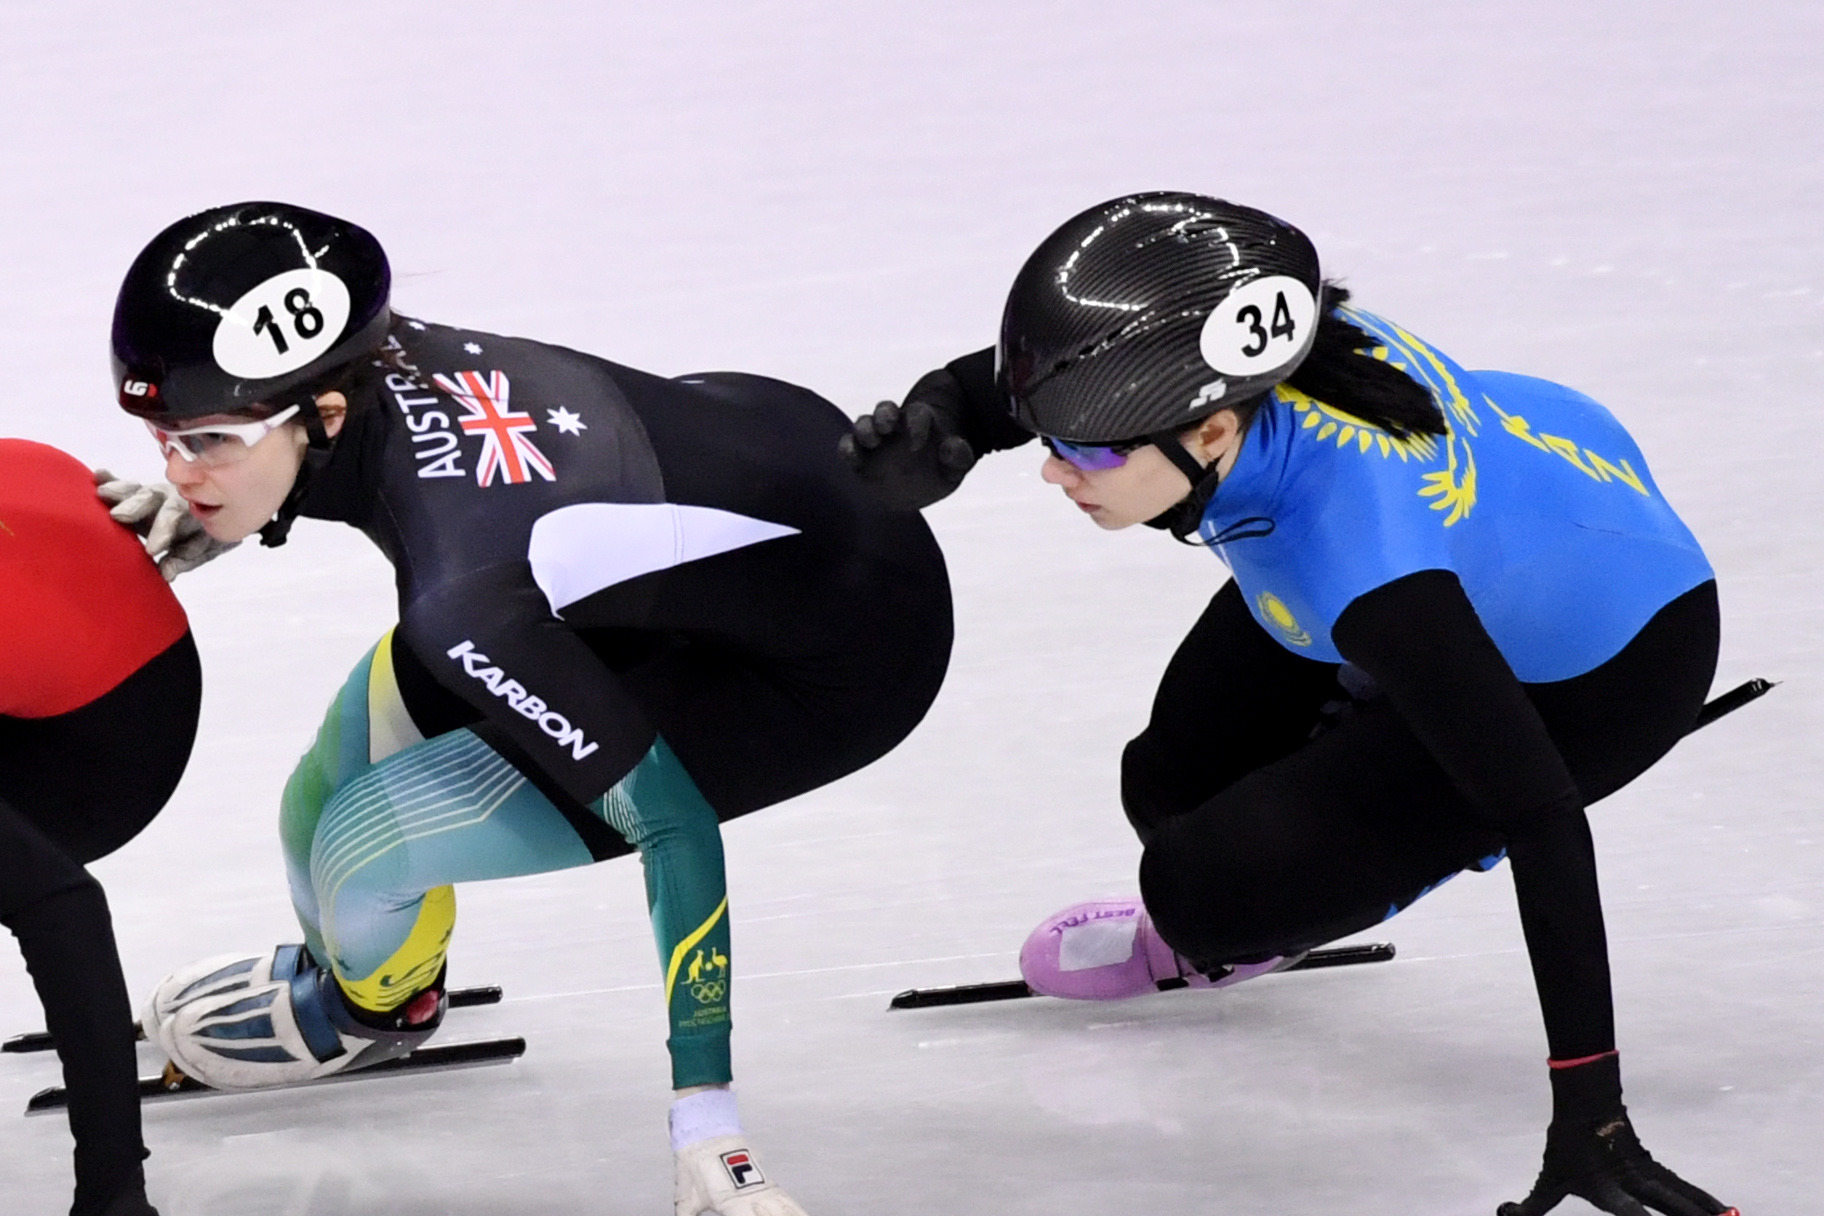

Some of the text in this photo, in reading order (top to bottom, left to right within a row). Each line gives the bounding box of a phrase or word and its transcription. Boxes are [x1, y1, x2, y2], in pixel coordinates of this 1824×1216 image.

[253, 287, 324, 355] 18
[1236, 290, 1295, 357] 34
[1482, 393, 1650, 497] KAZ
[447, 640, 599, 761] KARBON
